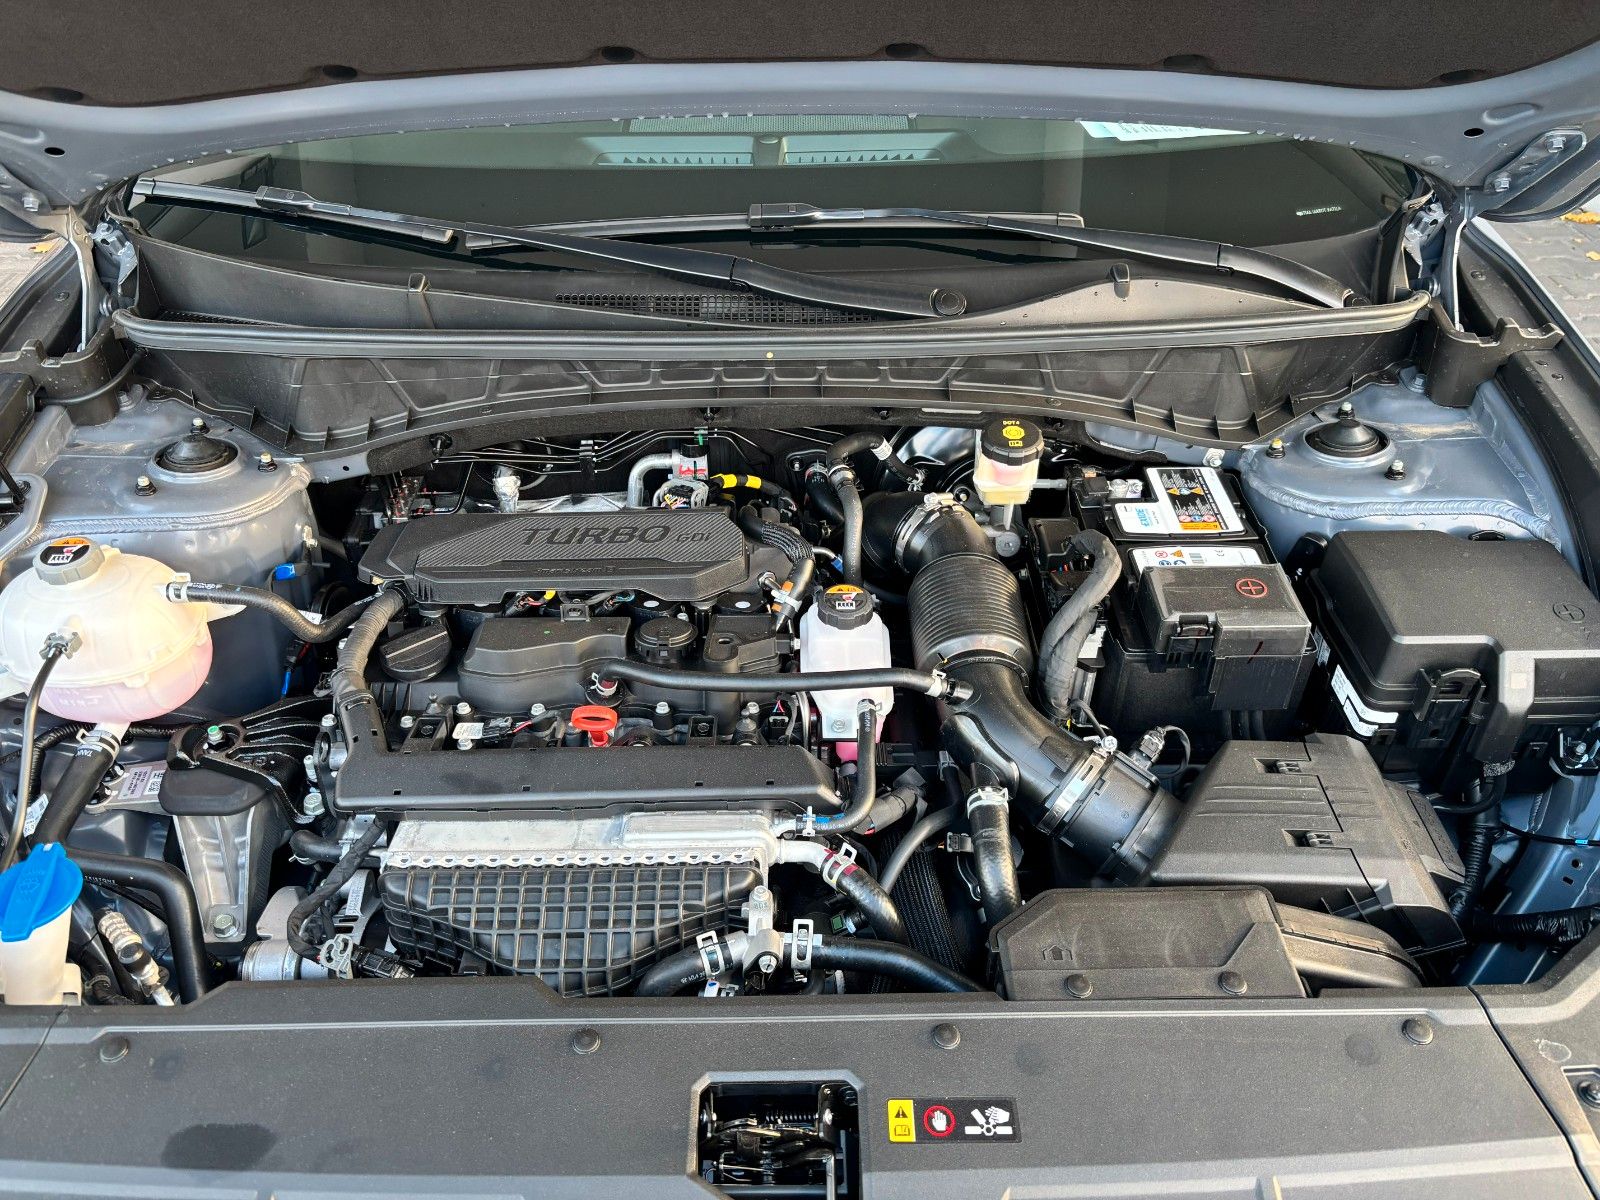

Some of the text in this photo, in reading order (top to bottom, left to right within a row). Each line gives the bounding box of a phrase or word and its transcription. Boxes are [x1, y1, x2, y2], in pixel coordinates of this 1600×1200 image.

[1135, 507, 1149, 527] EXIDE
[521, 526, 711, 545] TURBO GDi
